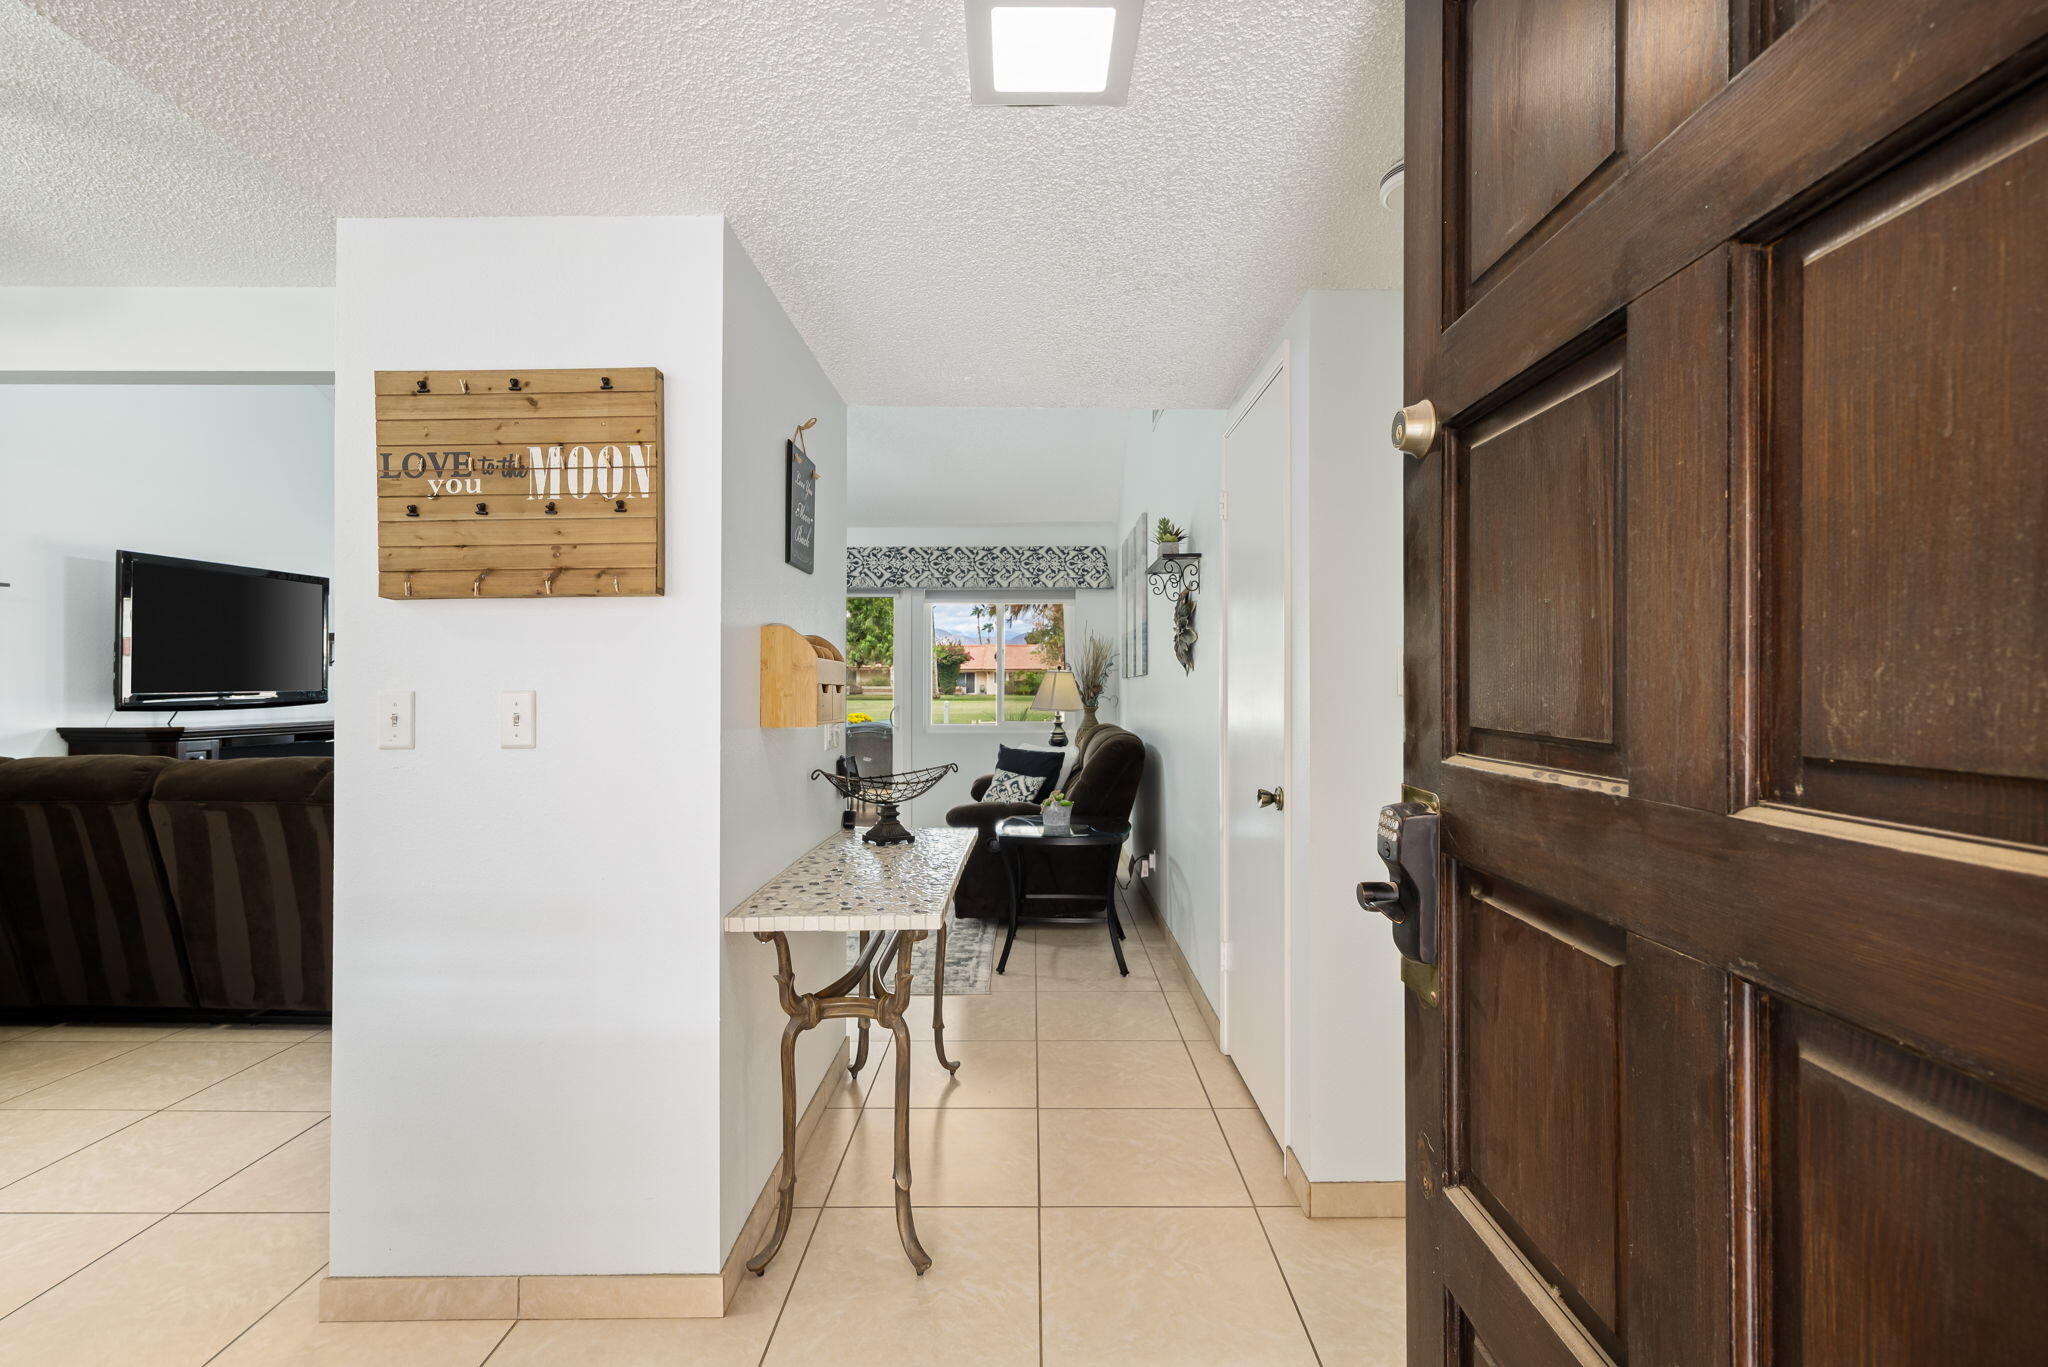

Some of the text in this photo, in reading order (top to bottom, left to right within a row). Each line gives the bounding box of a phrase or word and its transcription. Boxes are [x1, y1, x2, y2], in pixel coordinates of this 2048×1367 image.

[379, 444, 653, 501] LOVE to the MOON
[427, 477, 484, 500] you
